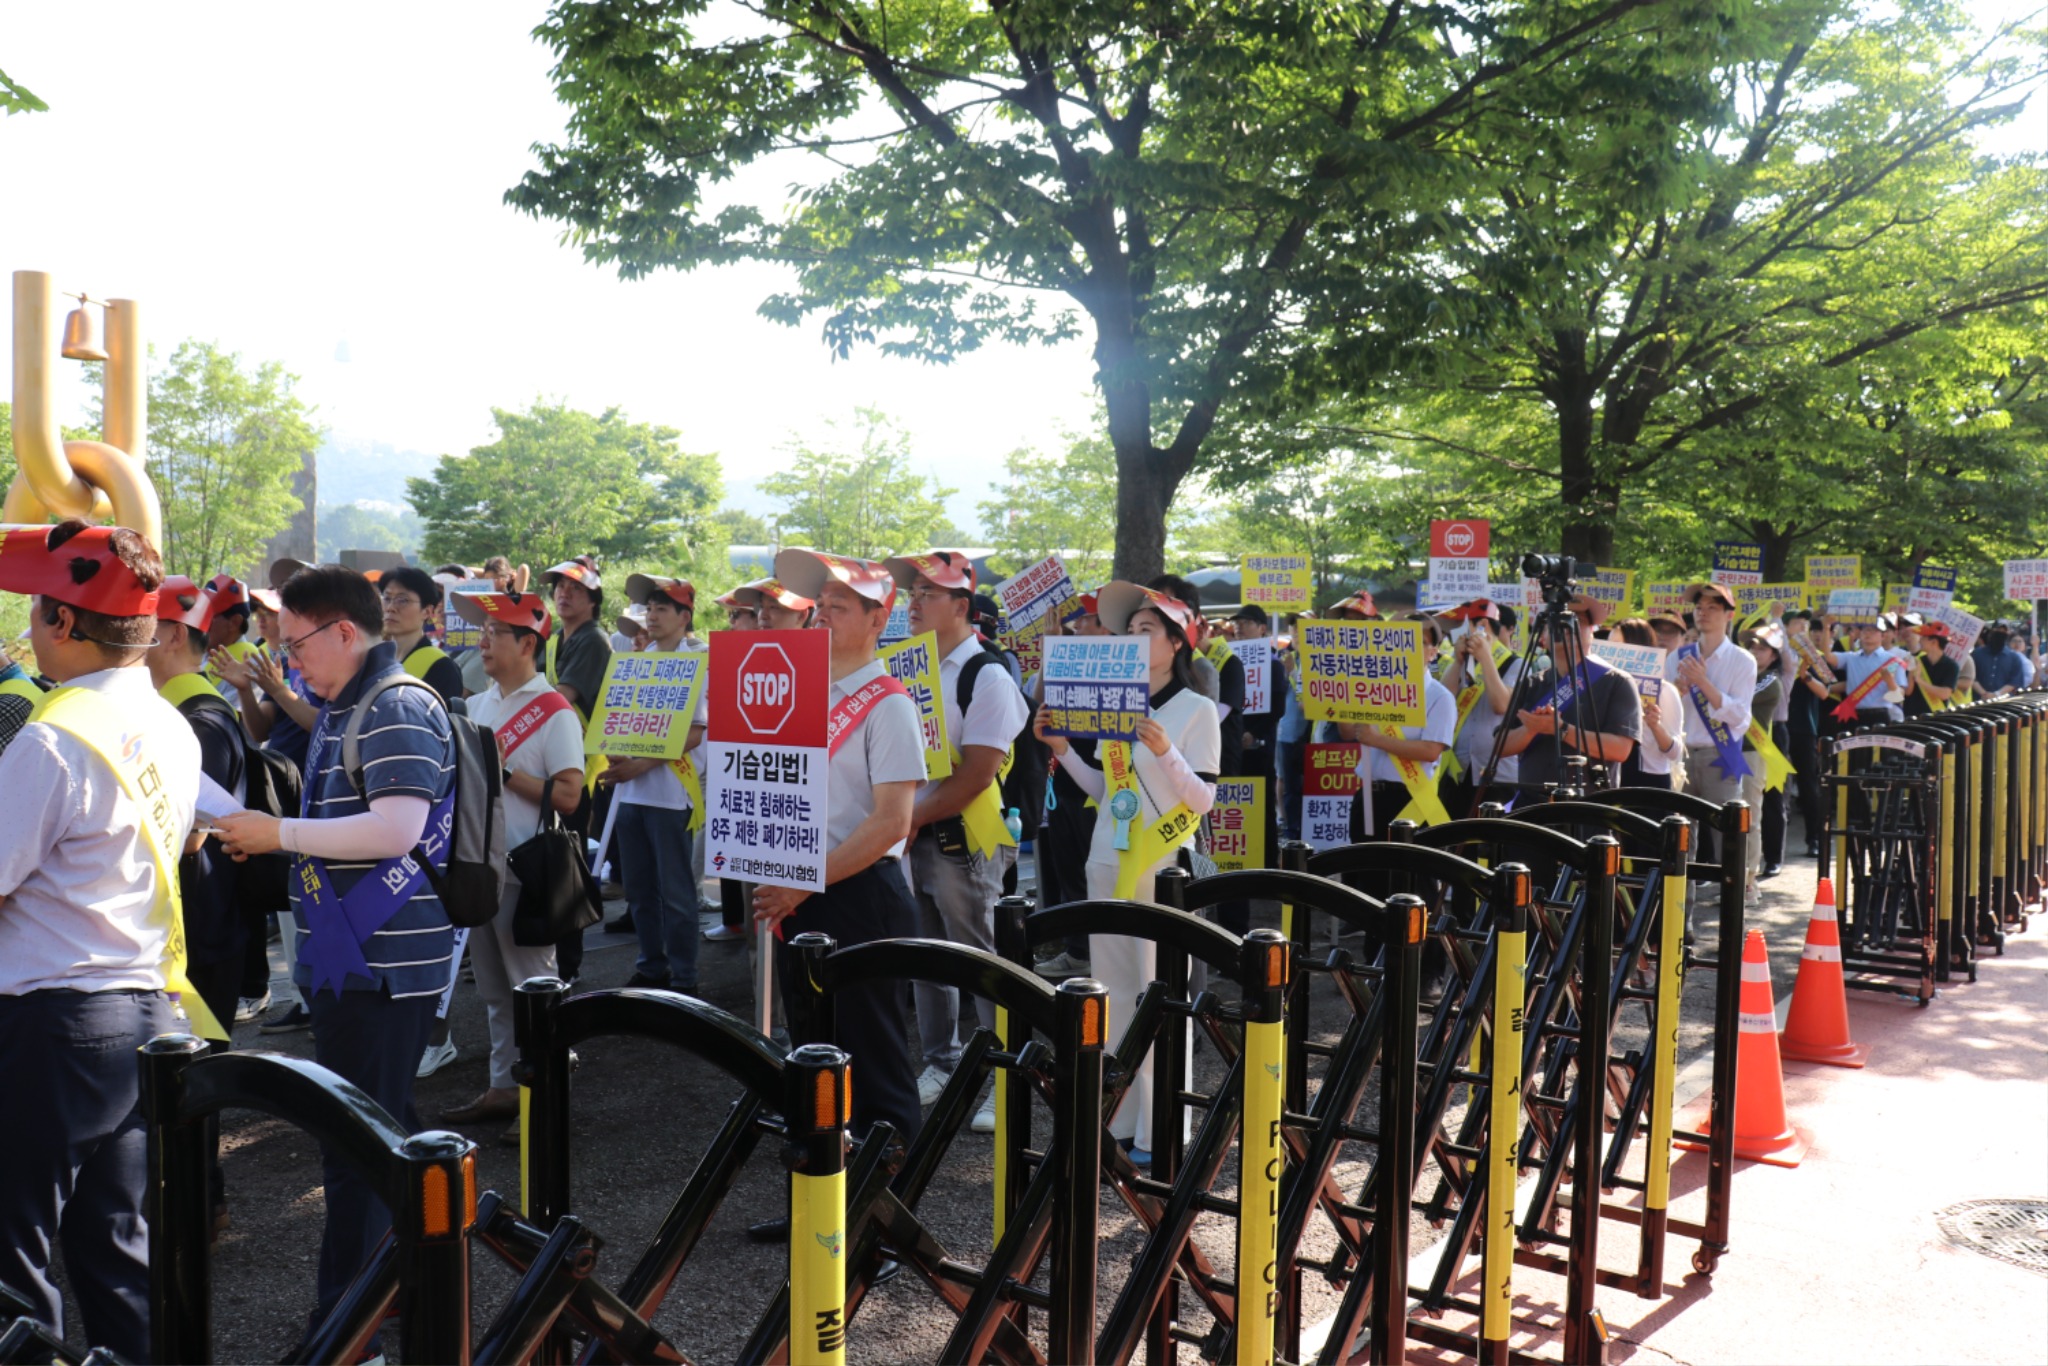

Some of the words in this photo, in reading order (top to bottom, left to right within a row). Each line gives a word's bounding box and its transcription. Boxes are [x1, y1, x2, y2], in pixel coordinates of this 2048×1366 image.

[1448, 534, 1471, 546] STOP
[1438, 560, 1480, 571] 기습입법!
[1050, 644, 1068, 660] 사고
[1089, 644, 1111, 660] 아픈
[1112, 644, 1125, 660] 내
[1305, 626, 1335, 650] 피해자
[1338, 627, 1369, 651] 치료가
[1372, 628, 1415, 652] 우선이지
[612, 658, 653, 681] 교통사고
[654, 658, 699, 683] 피해자의
[1045, 662, 1084, 678] 치료비도
[1085, 662, 1098, 678] 내
[1099, 662, 1146, 679] 돈으로?
[1310, 653, 1408, 680] 자동차보험회사
[604, 685, 636, 708] 진료권
[637, 685, 690, 711] 박탈행위를
[743, 672, 790, 706] STOP
[847, 683, 886, 715] 치료권
[1309, 679, 1350, 704] 이익이
[1355, 682, 1417, 708] 우선이냐!
[513, 705, 545, 735] 치료권
[604, 712, 673, 738] 중단하라!
[723, 749, 808, 785] 기습입법!
[1312, 750, 1359, 768] 셀프심
[1216, 783, 1254, 805] 해자의
[1320, 773, 1361, 790] OUT!
[720, 788, 755, 816] 치료권
[759, 791, 811, 821] 침해하는
[1308, 800, 1332, 818] 환자
[711, 818, 731, 843] 8주
[734, 820, 759, 847] 제한
[762, 823, 819, 855] 폐기하라!
[1312, 823, 1351, 842] 보장하
[301, 863, 322, 905] 반대!
[742, 858, 818, 884] 대한한의사협회
